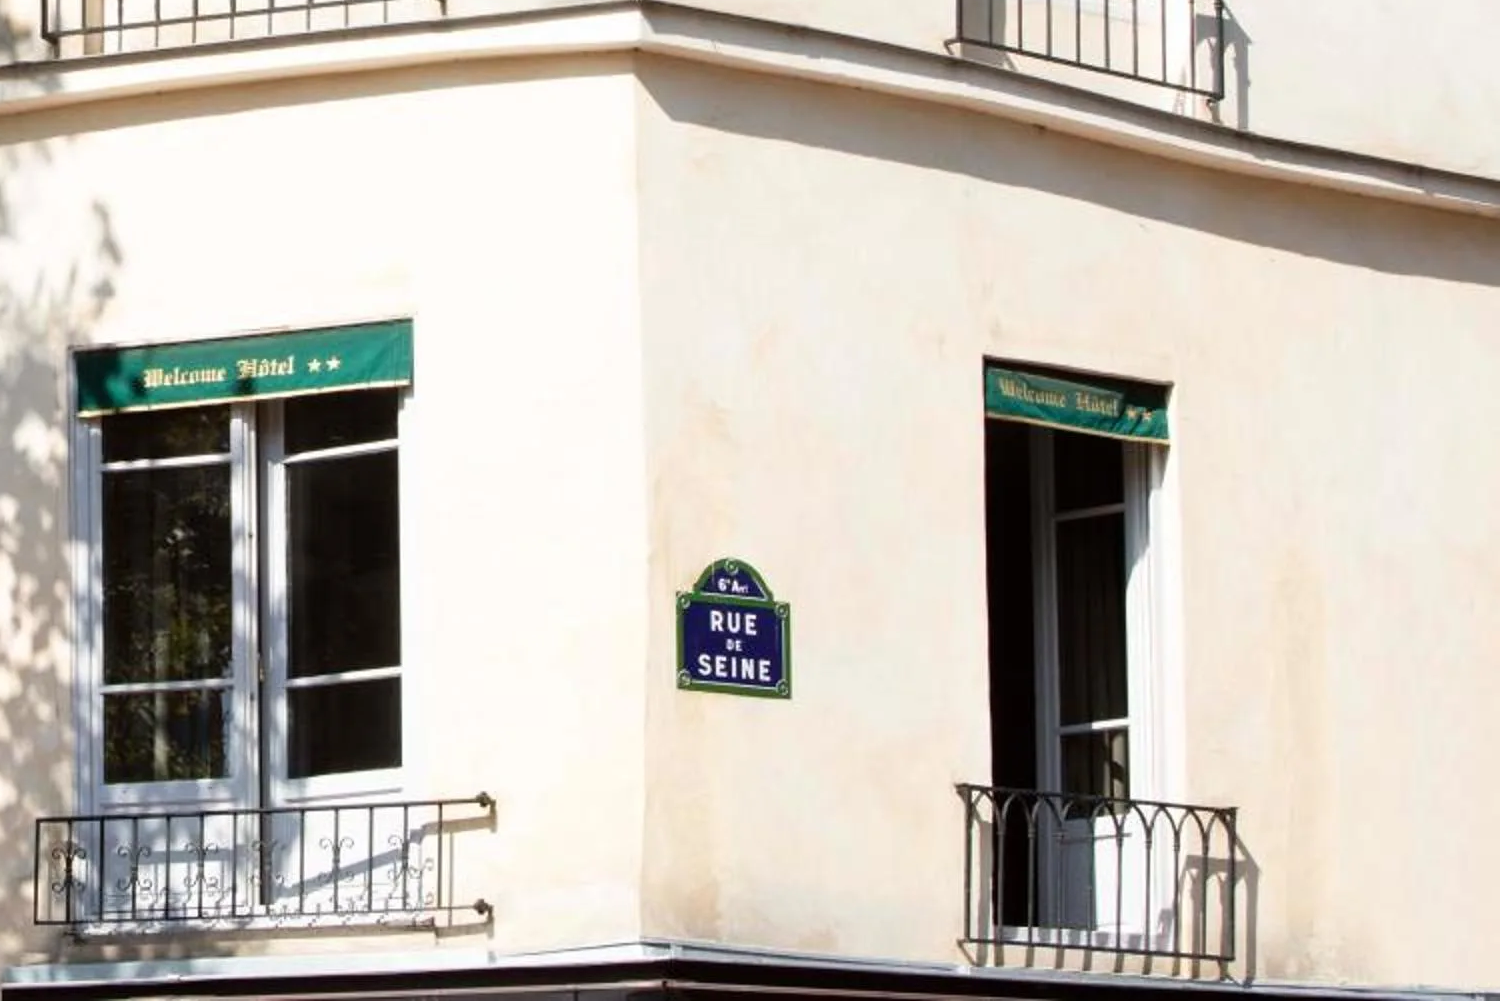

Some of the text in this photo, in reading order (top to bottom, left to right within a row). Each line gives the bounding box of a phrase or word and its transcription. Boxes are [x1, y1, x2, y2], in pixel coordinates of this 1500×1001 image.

[143, 354, 296, 388] Welcome Hôtel
[998, 377, 1067, 408] Welcome
[709, 609, 758, 636] RUE
[725, 638, 743, 652] DE
[697, 653, 772, 682] SEINE
